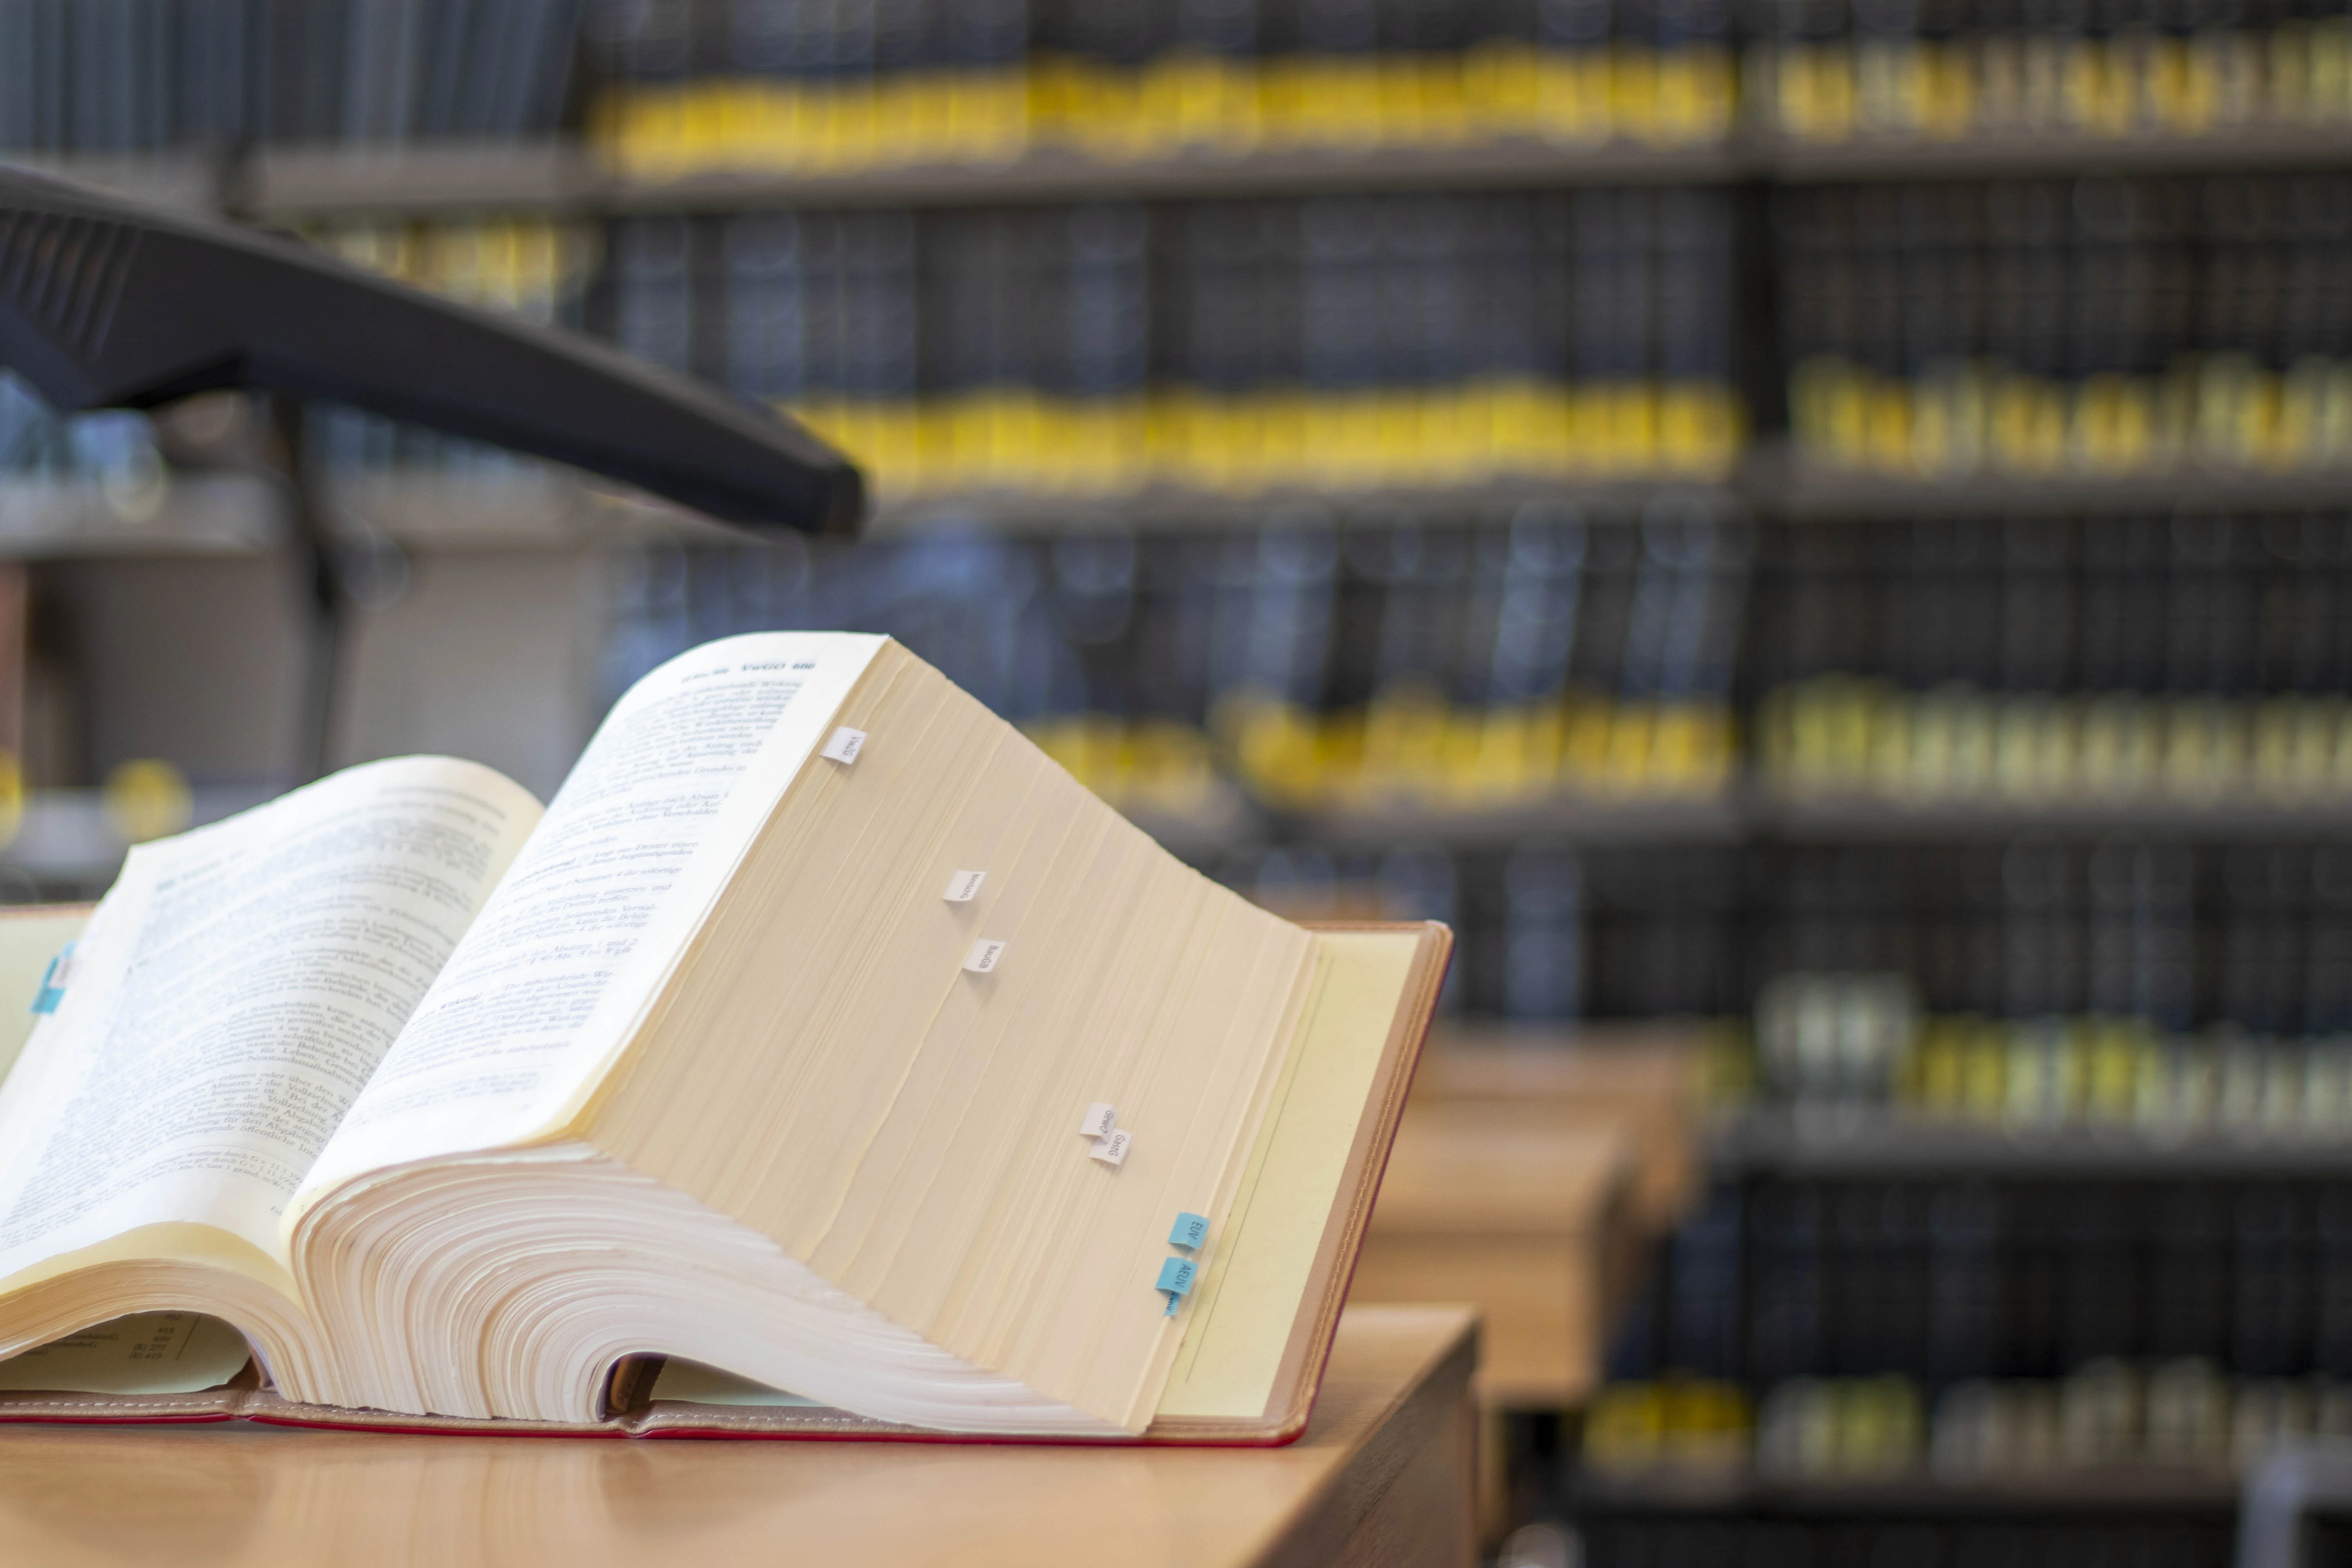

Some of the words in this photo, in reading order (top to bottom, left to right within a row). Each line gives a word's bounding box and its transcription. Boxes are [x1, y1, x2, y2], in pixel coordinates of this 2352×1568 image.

[694, 766, 734, 774] Grundes
[663, 808, 719, 818] Verschulden
[635, 842, 668, 851] Dritter
[978, 945, 999, 969] BauGB
[298, 1041, 341, 1060] Behörde
[266, 1079, 283, 1087] die
[289, 1075, 313, 1087] über
[315, 1085, 334, 1097] den
[268, 1095, 328, 1125] Vollziehung
[311, 1100, 328, 1113] der
[242, 1117, 263, 1126] den
[273, 1115, 290, 1126] des
[283, 1109, 327, 1134] Abgaben
[240, 1125, 296, 1147] öffentliche
[1188, 1221, 1203, 1240] EUV
[1174, 1263, 1192, 1288] AEUV
